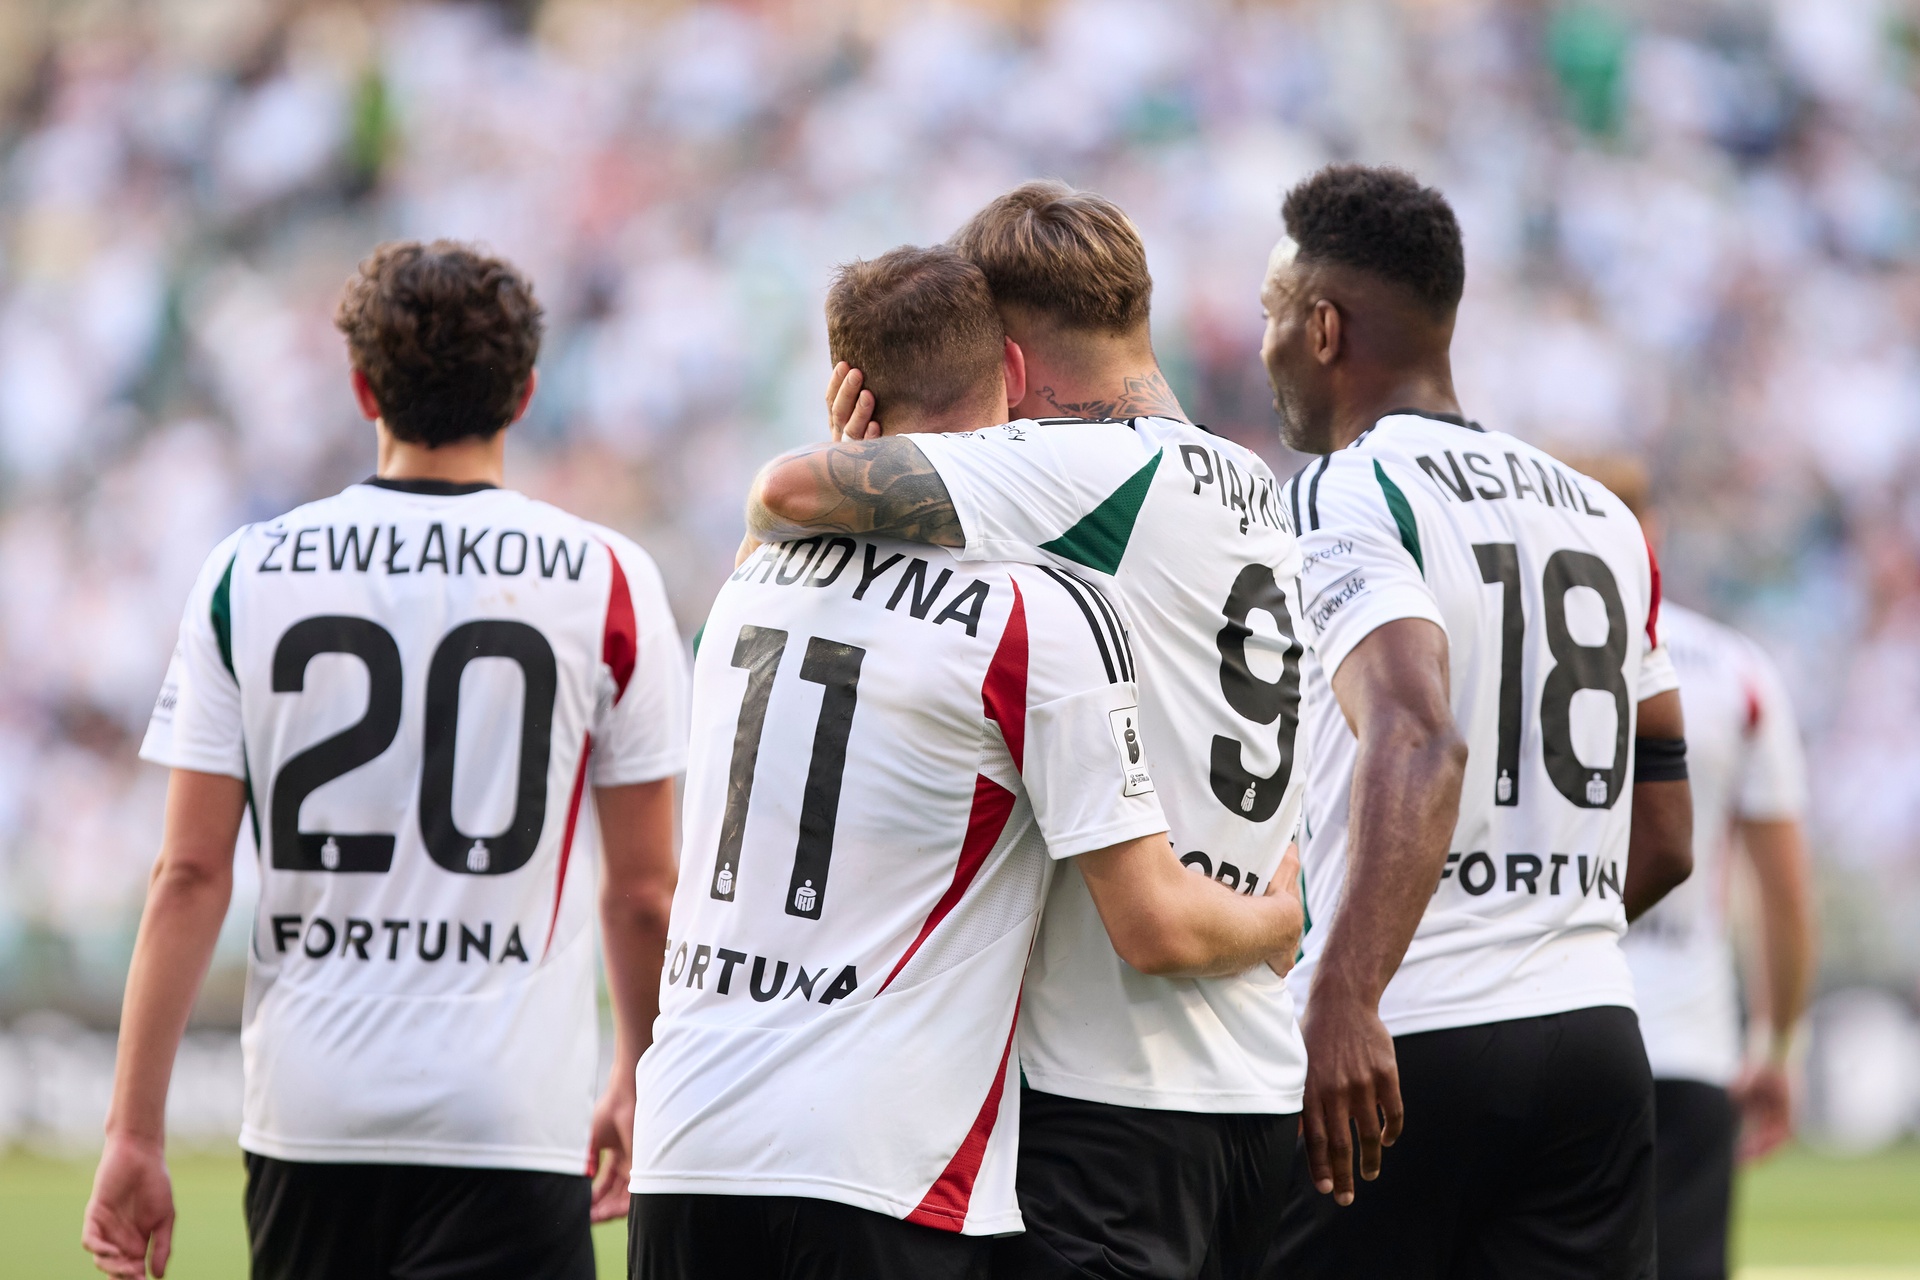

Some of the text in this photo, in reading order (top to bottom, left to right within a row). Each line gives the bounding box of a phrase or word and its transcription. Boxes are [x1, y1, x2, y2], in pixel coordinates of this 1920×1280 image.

[258, 522, 588, 581] ŻEWŁAKOW
[1302, 540, 1353, 575] peedy
[1472, 543, 1629, 810] 18
[271, 615, 558, 876] 20
[711, 626, 867, 921] 11
[1210, 563, 1302, 823] 9
[271, 914, 530, 963] FORTUNA
